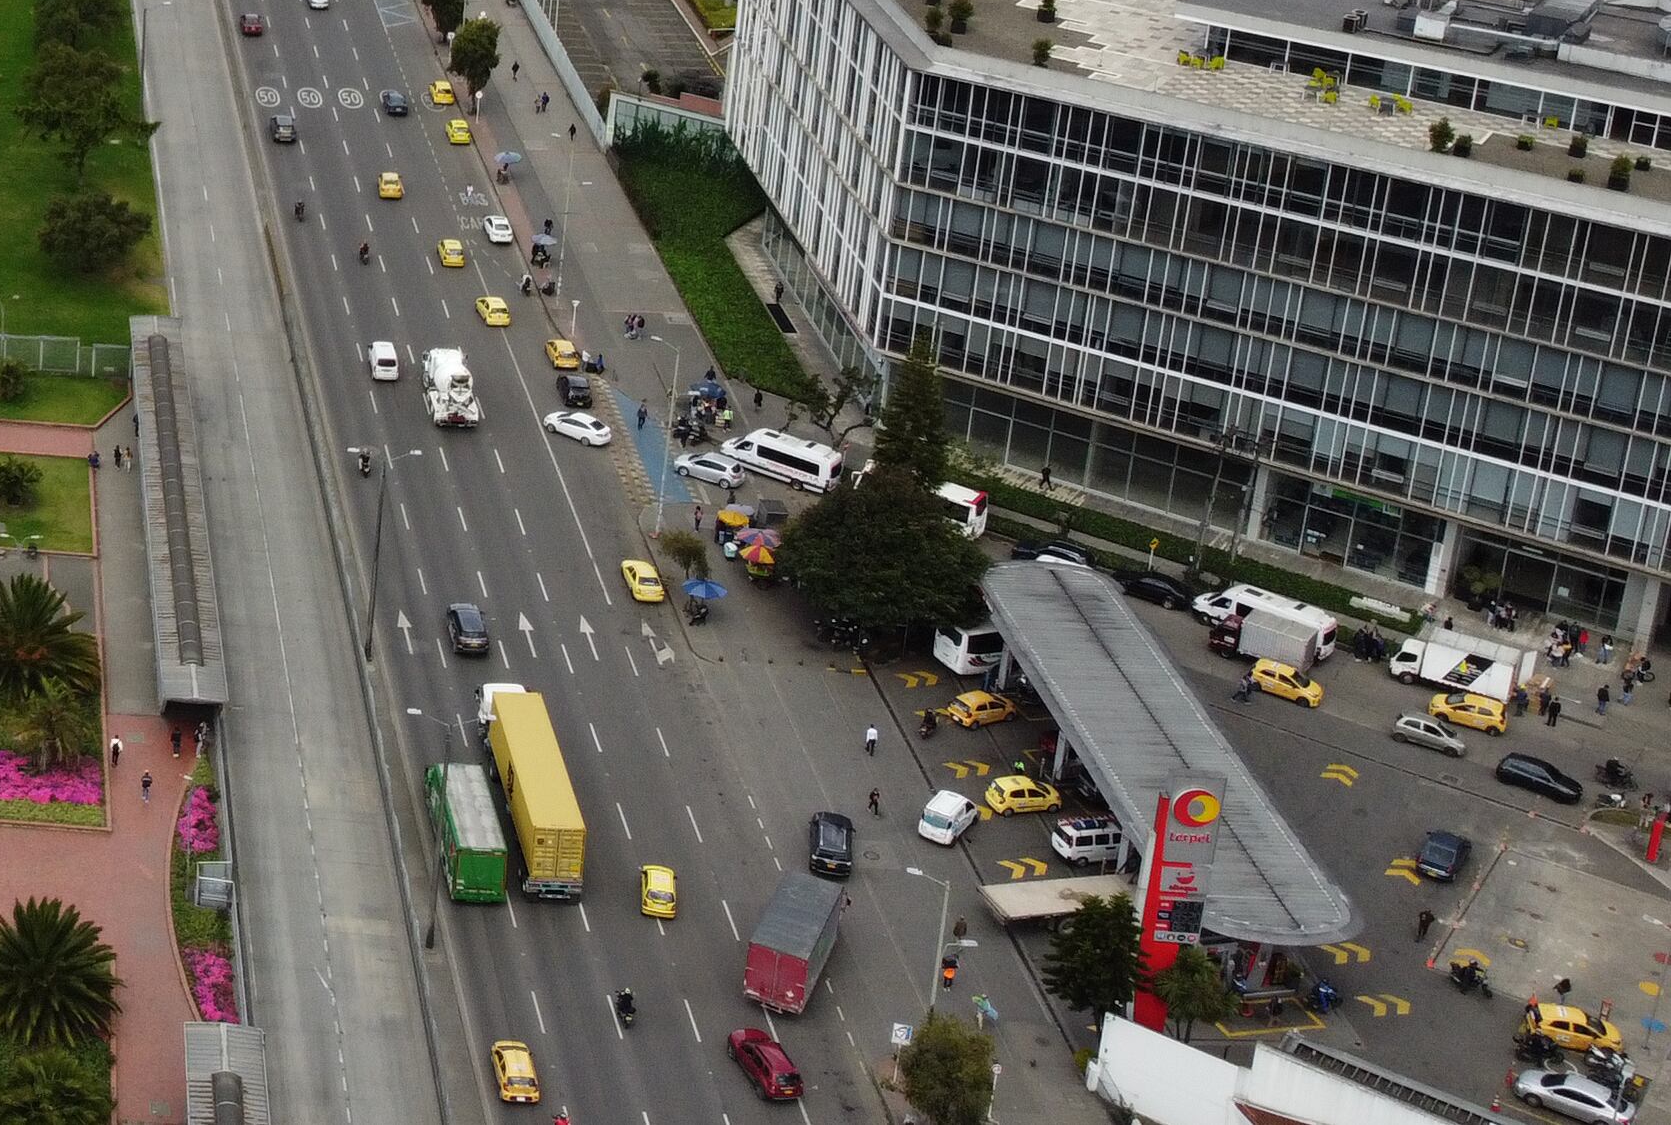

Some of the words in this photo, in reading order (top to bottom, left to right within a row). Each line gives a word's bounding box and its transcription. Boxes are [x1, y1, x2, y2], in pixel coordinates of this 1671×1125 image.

[259, 90, 276, 103] 50
[301, 91, 318, 104] 50
[341, 92, 359, 104] 50
